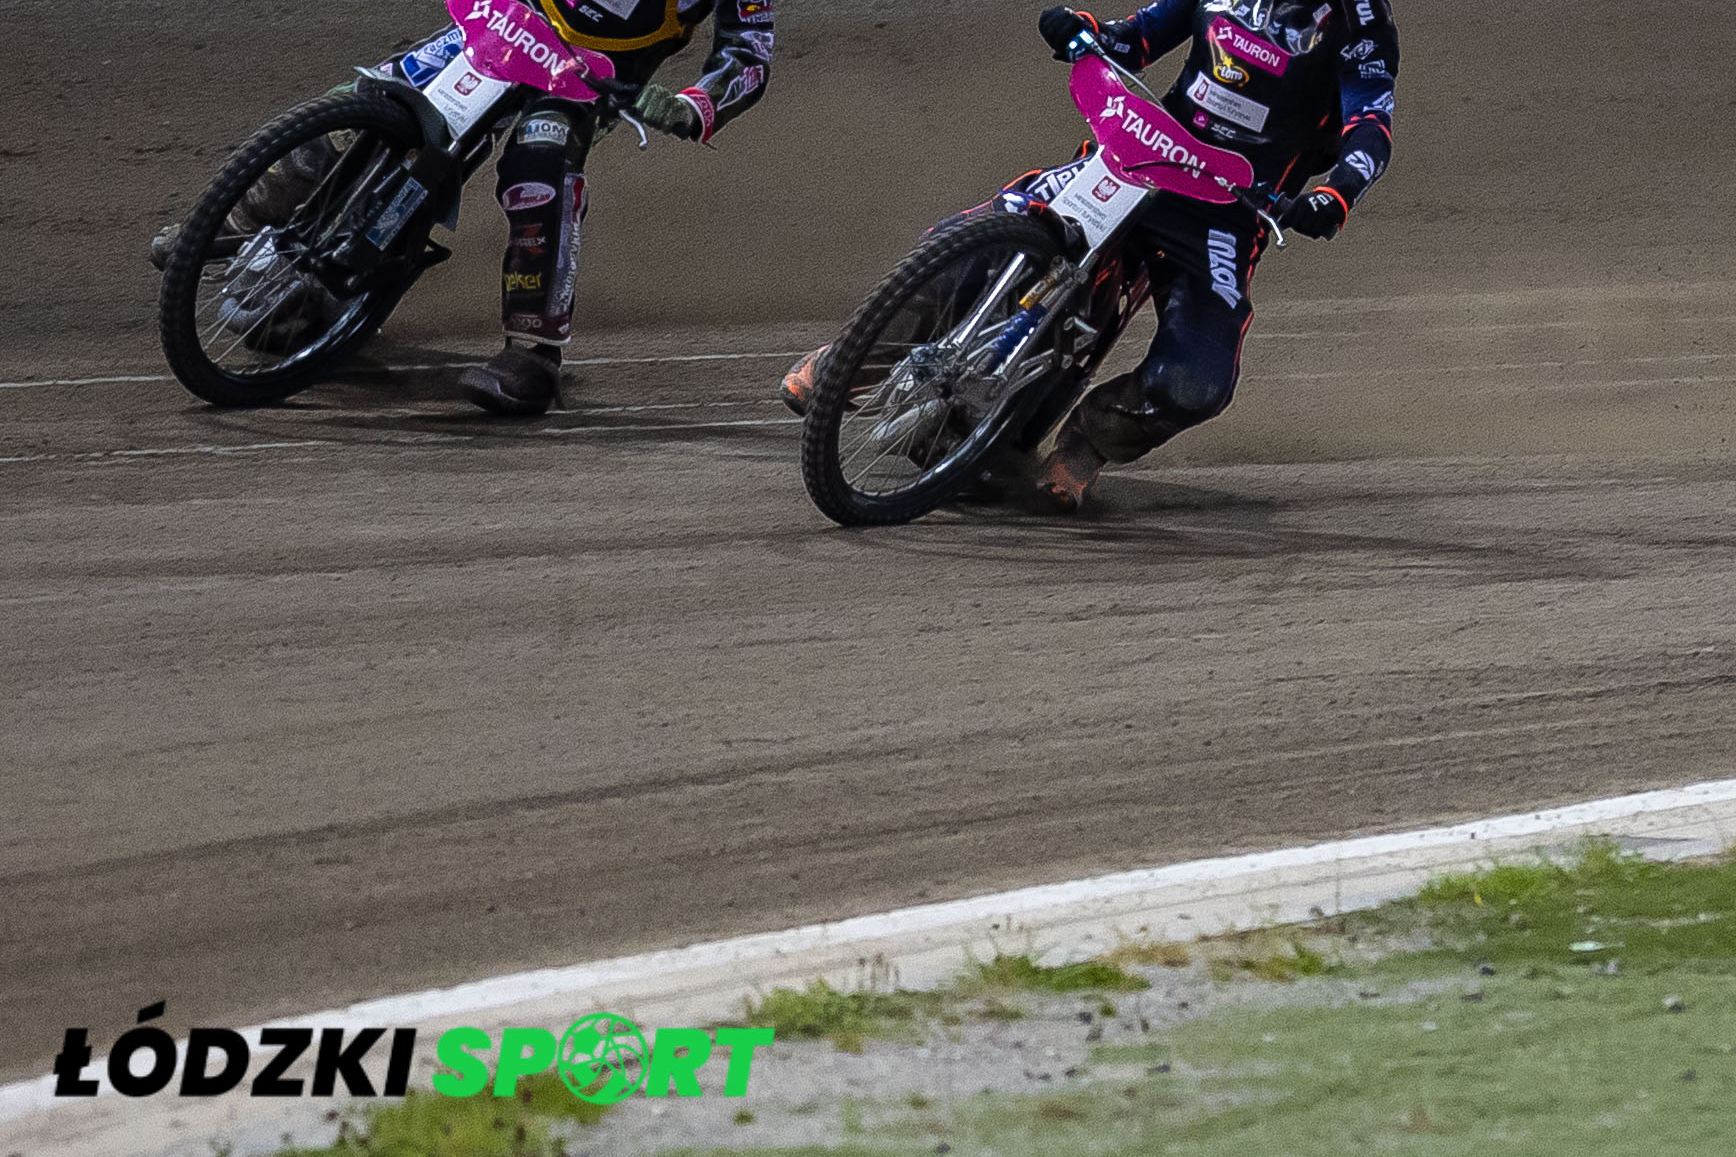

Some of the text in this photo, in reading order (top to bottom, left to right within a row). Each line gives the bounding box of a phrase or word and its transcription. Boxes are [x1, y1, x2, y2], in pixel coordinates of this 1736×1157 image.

[485, 8, 567, 77] TAURON
[1232, 33, 1281, 68] TAURON
[1221, 65, 1243, 81] LOTTO
[1122, 110, 1208, 180] TAURON
